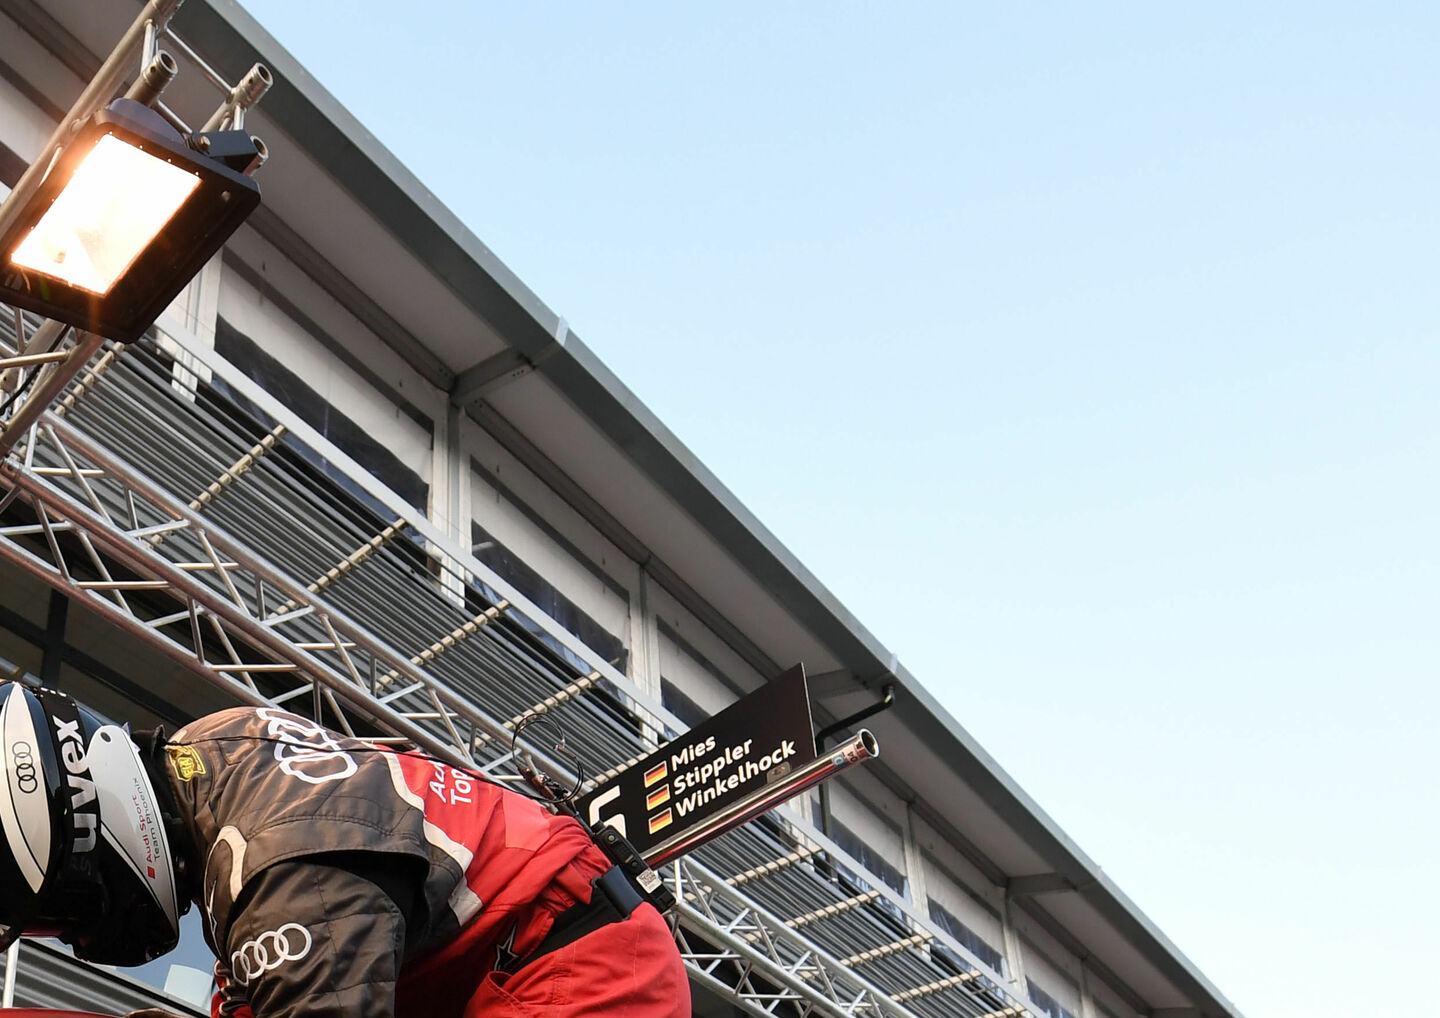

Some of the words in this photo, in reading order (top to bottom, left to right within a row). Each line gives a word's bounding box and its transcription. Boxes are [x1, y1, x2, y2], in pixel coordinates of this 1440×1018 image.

[670, 735, 717, 772] Mies
[672, 737, 753, 795] Stippler
[51, 714, 97, 853] uvex
[674, 740, 796, 818] Winkelhock
[132, 794, 147, 831] Sport
[133, 777, 153, 824] Phoenix
[143, 833, 153, 863] Audi
[150, 827, 161, 861] Team
